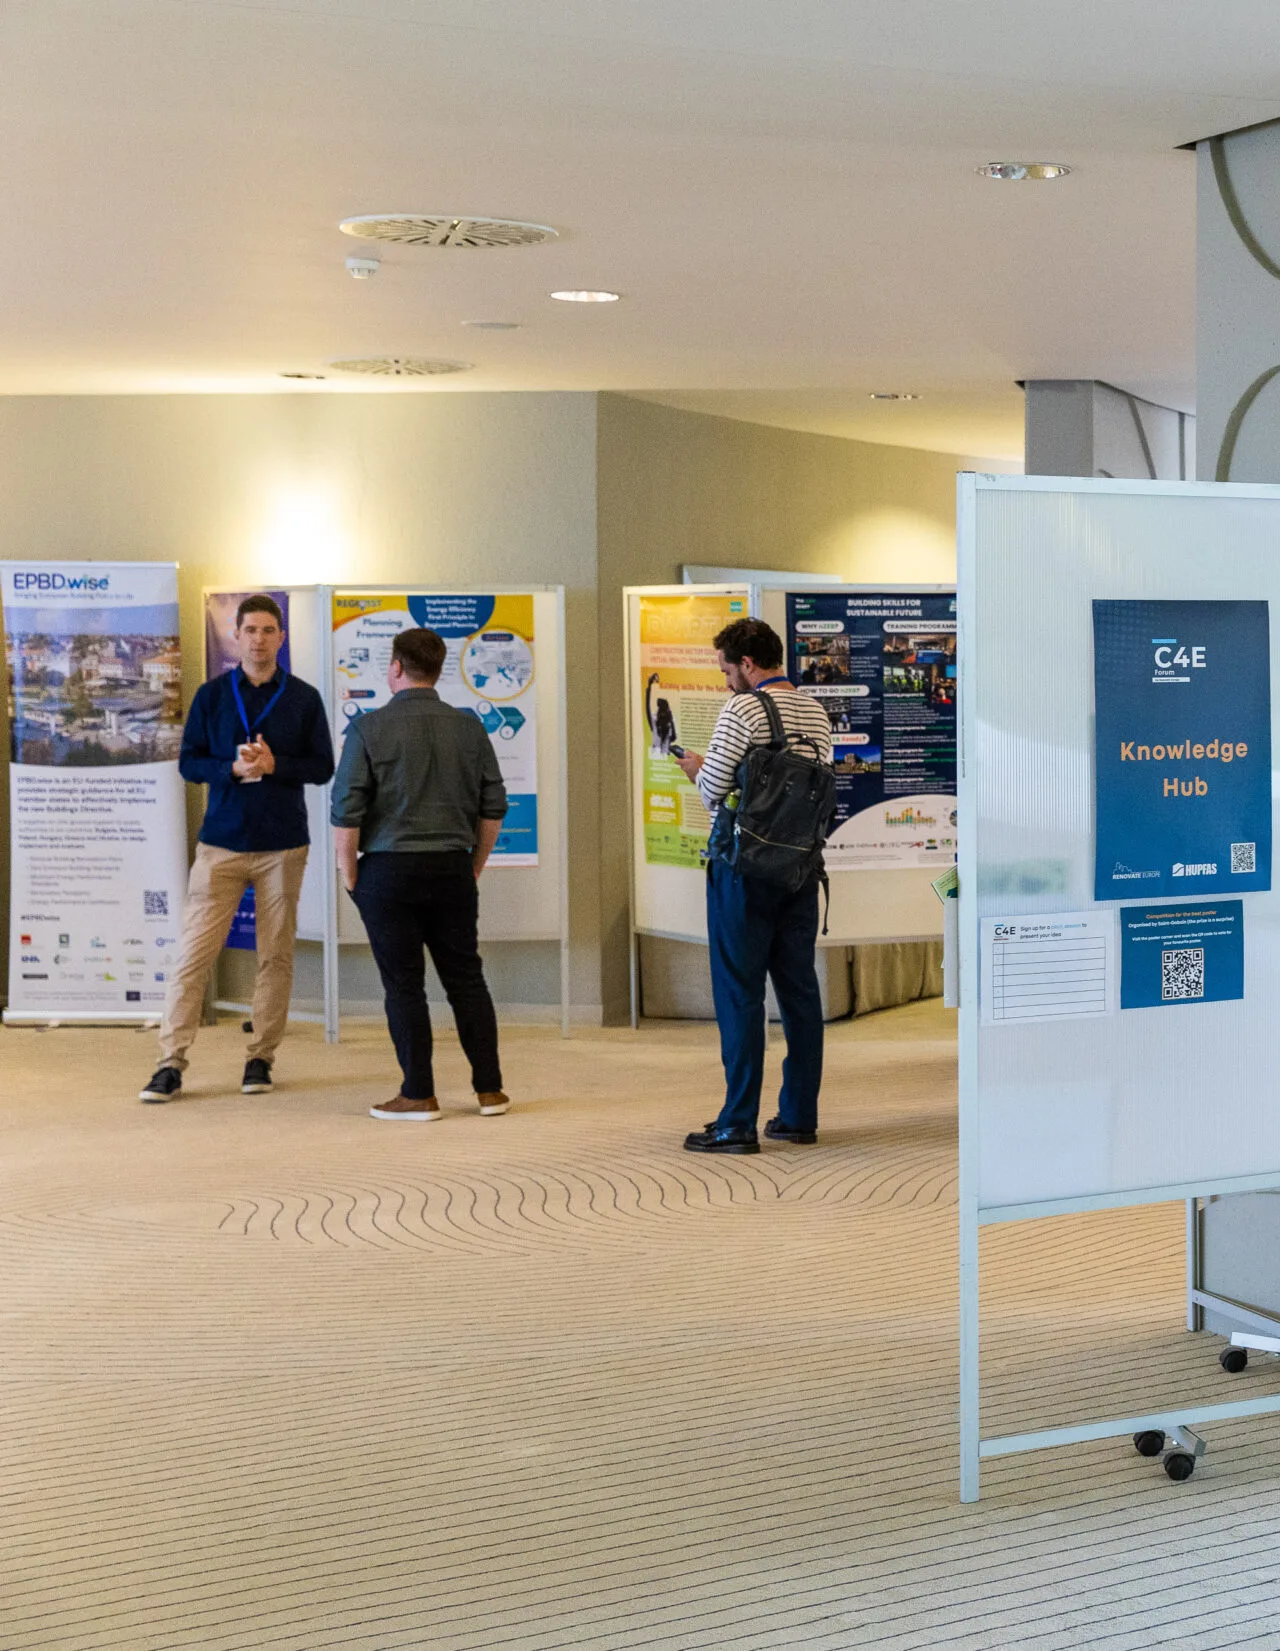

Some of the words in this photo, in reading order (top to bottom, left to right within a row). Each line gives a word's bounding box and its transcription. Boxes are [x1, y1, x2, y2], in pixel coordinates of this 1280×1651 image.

[847, 598, 882, 608] BUILDING
[883, 598, 906, 607] SKILLS
[906, 598, 922, 607] FOR
[846, 609, 895, 617] SUSTAINABLE
[895, 609, 923, 617] FUTURE
[1154, 646, 1207, 669] C4E
[1120, 738, 1249, 763] Knowledge
[1163, 776, 1209, 797] Hub
[1185, 863, 1218, 876] HUPFAS
[1112, 871, 1142, 880] RENOVATE
[1142, 870, 1161, 879] EUROPE
[1157, 919, 1188, 927] Saint-Gobain
[994, 926, 1017, 936] C4E
